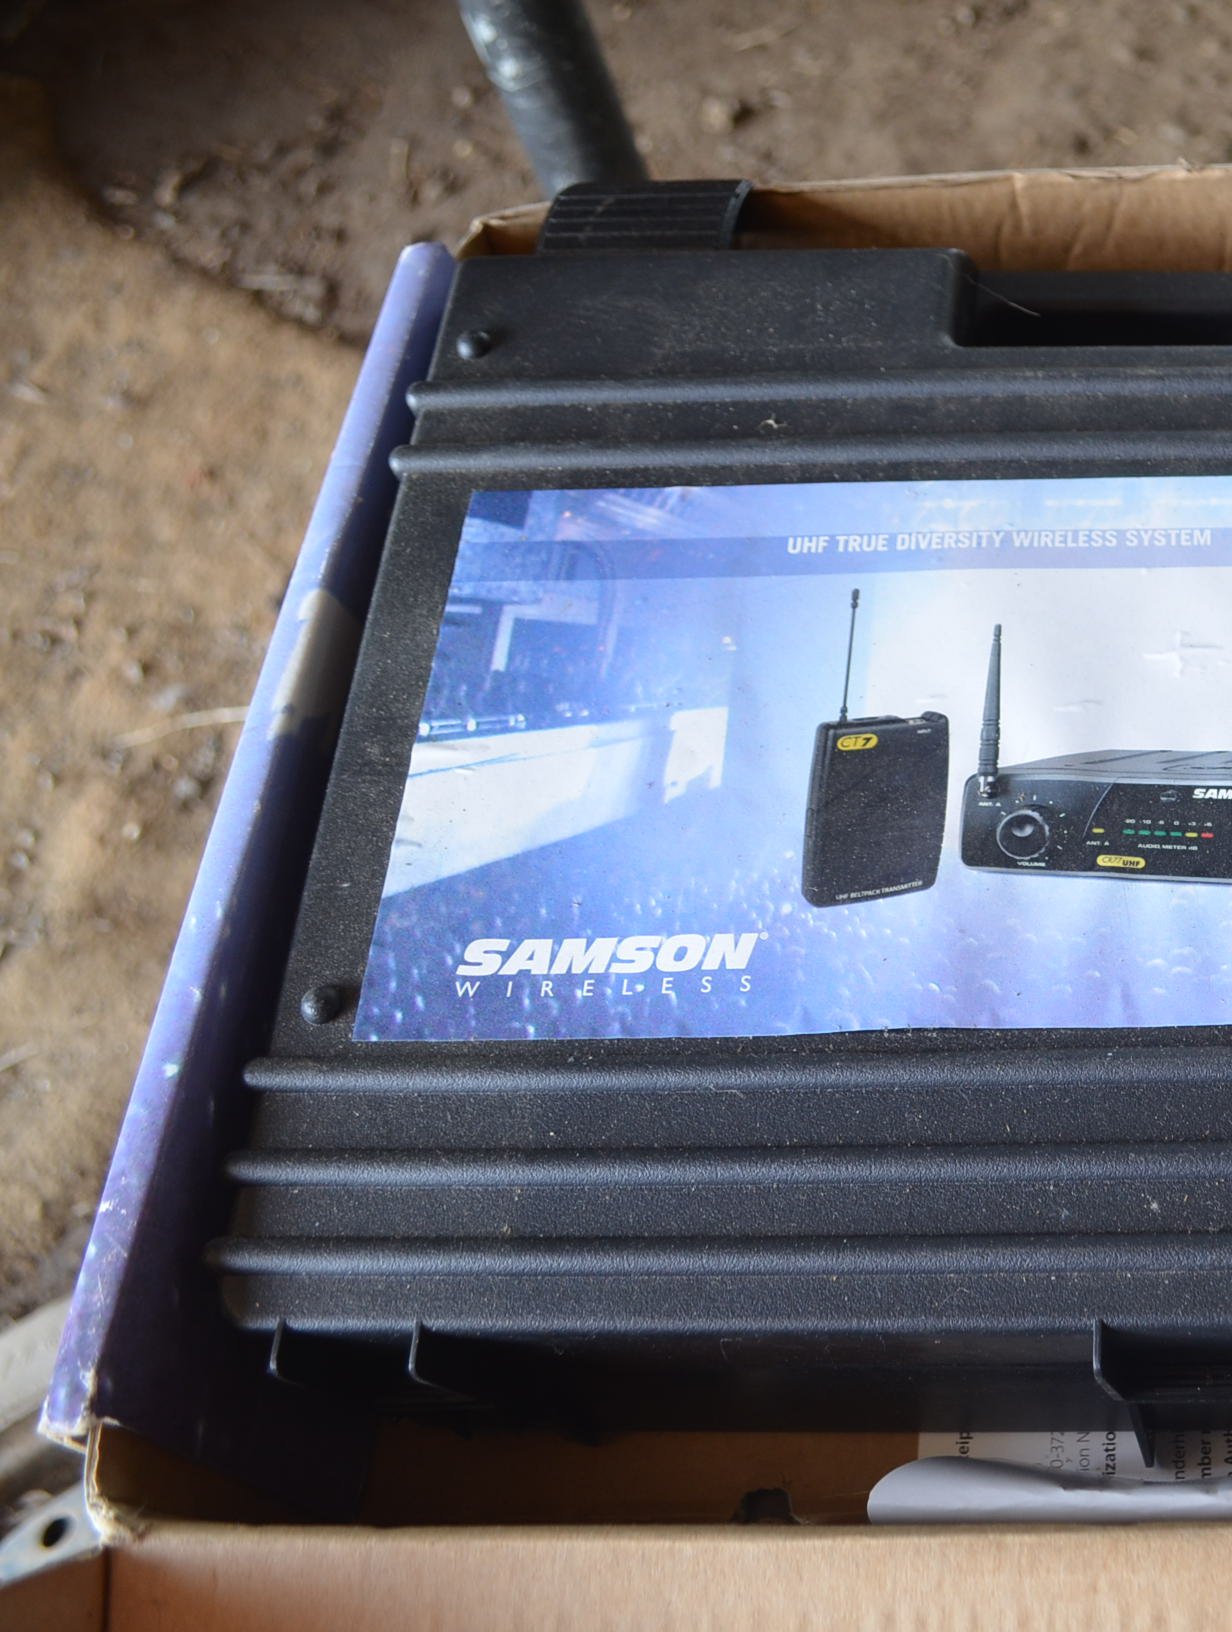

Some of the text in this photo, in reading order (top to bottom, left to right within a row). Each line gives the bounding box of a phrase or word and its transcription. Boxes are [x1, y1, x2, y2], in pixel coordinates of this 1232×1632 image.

[786, 528, 1212, 554] UHF TRUE DIVERSITY WIRELESS SYSTEM
[455, 932, 759, 977] SAMSON
[455, 974, 752, 999] WIRELESS
